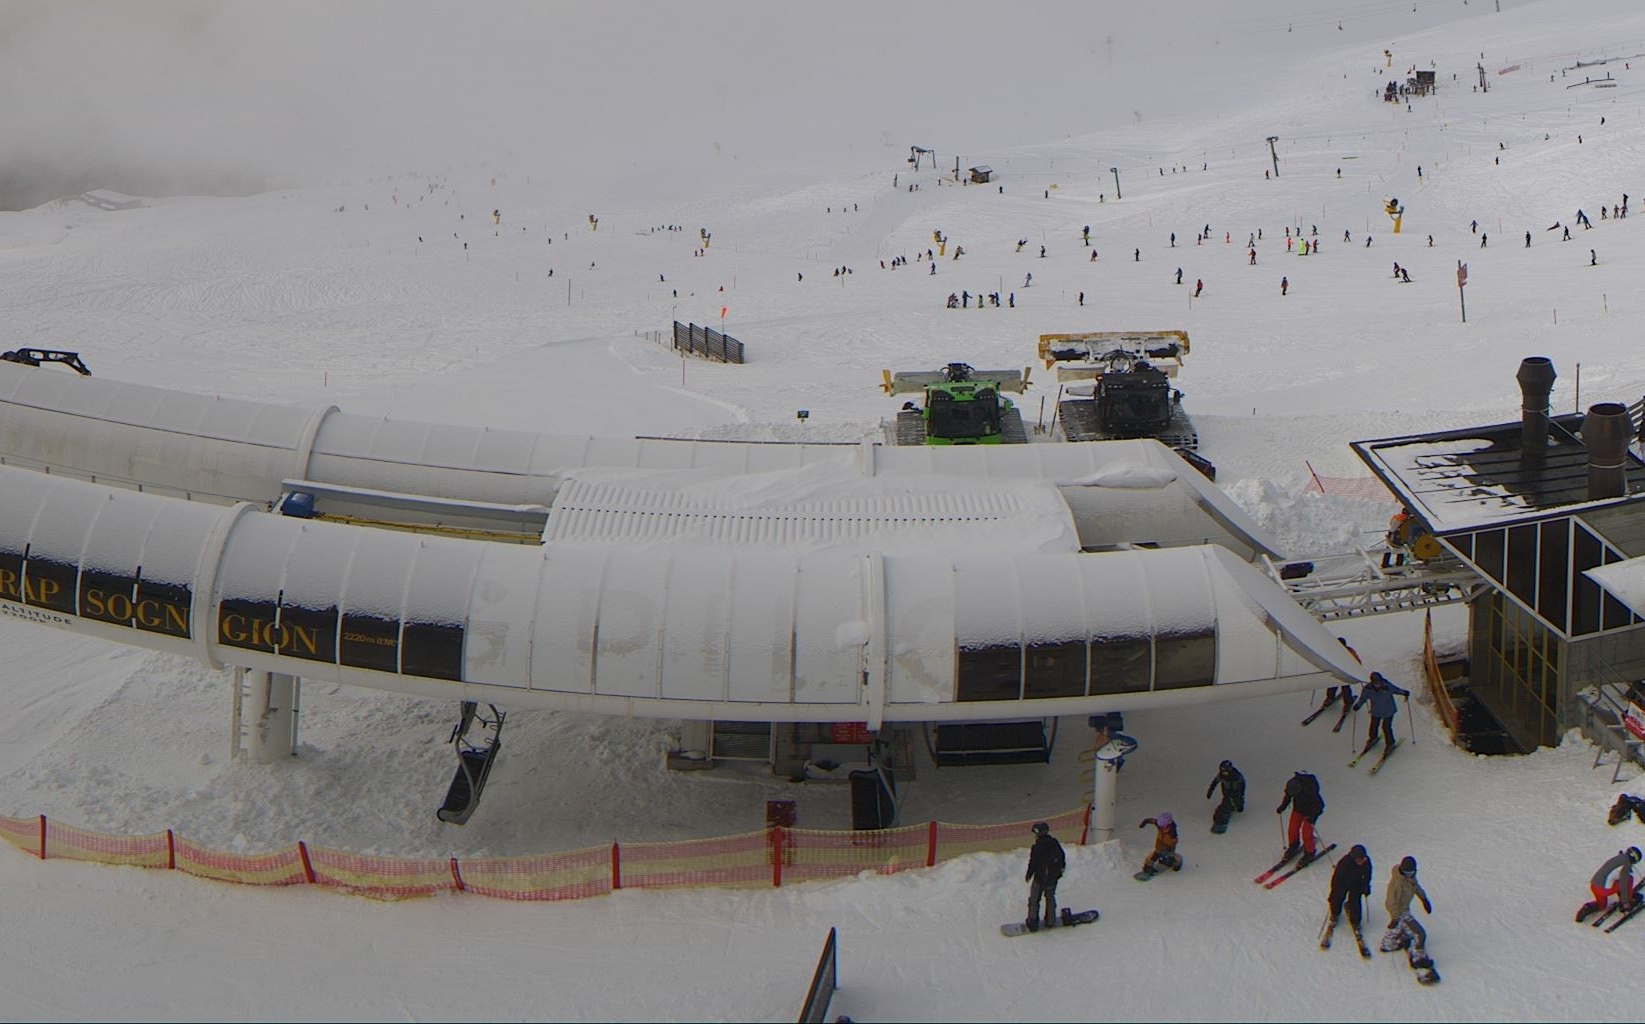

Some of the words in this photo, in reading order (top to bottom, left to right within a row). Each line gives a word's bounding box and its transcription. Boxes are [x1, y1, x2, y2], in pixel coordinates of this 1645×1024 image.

[2, 603, 72, 625] ALTITUDE
[86, 588, 189, 632] SOGN
[222, 614, 319, 655] GION
